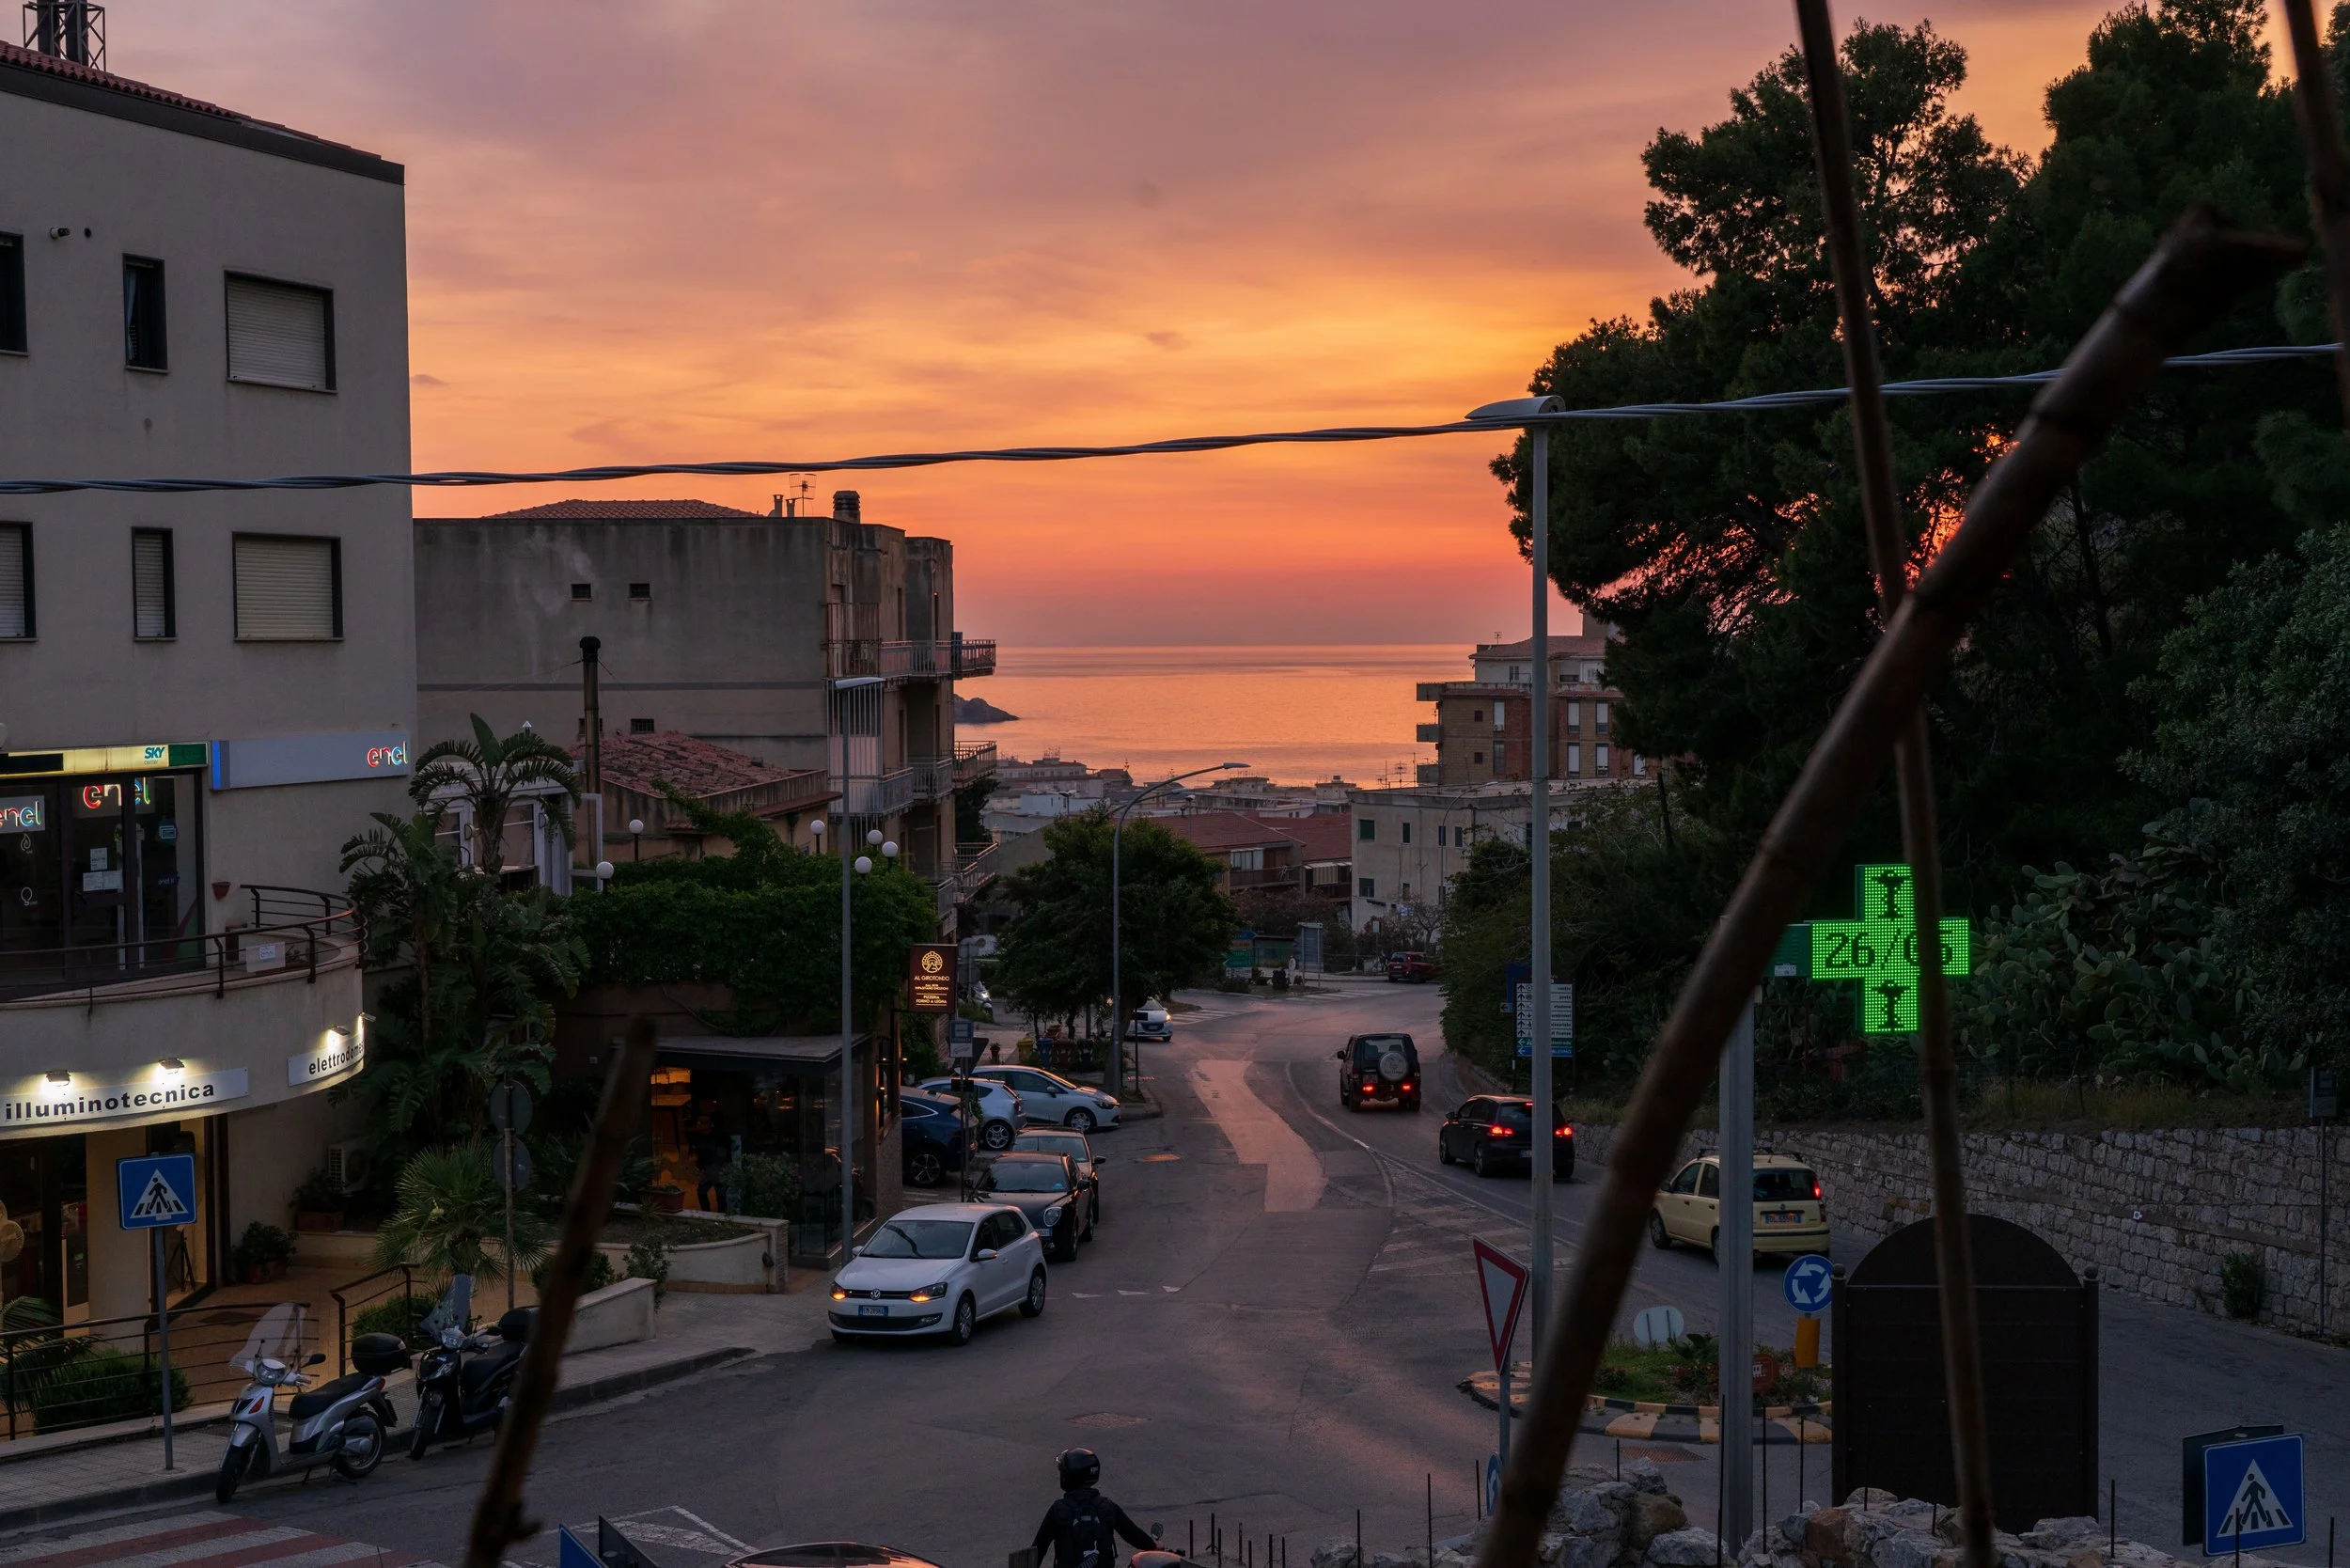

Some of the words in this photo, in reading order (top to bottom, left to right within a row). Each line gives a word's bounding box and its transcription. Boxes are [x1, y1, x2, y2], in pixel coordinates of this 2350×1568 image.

[144, 745, 165, 760] SKY
[368, 741, 409, 767] enel
[6, 1084, 214, 1121] illuminotecnica
